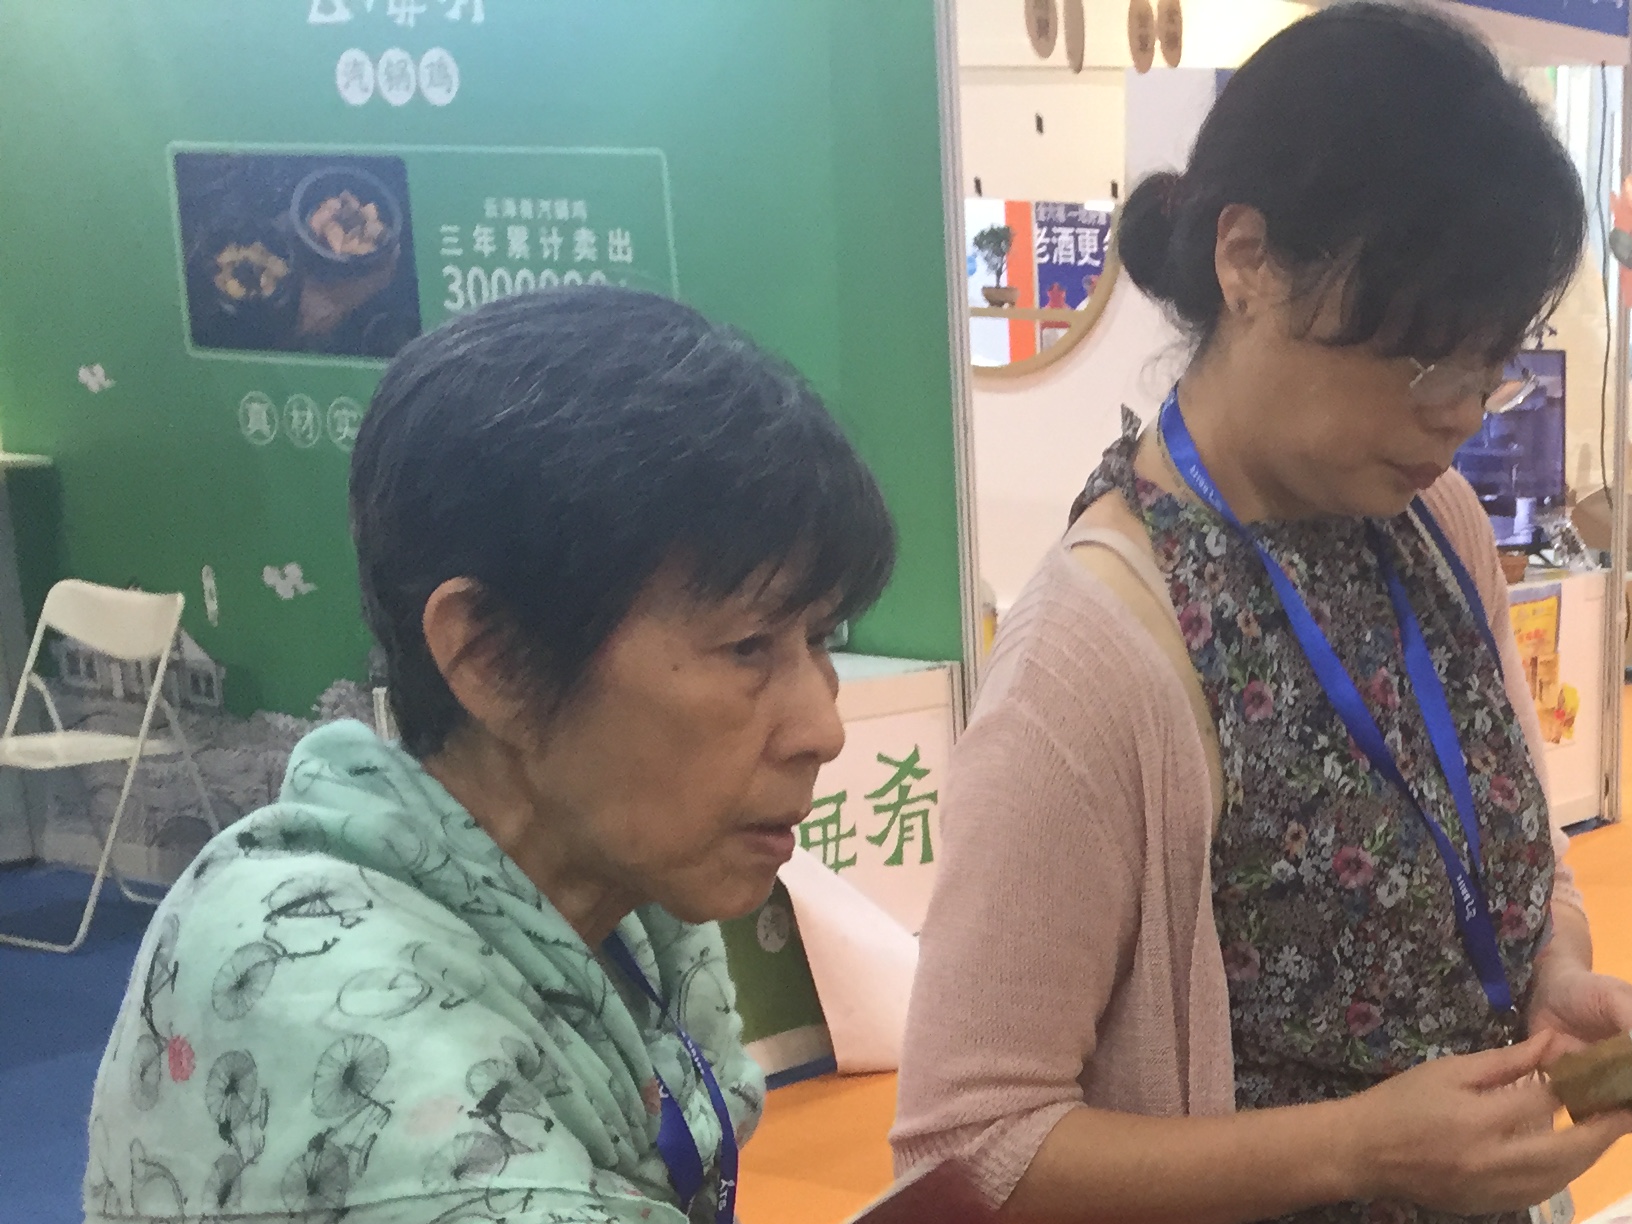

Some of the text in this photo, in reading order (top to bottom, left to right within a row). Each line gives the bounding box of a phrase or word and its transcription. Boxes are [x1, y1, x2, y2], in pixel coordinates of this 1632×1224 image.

[440, 223, 633, 264] 三年累计卖出
